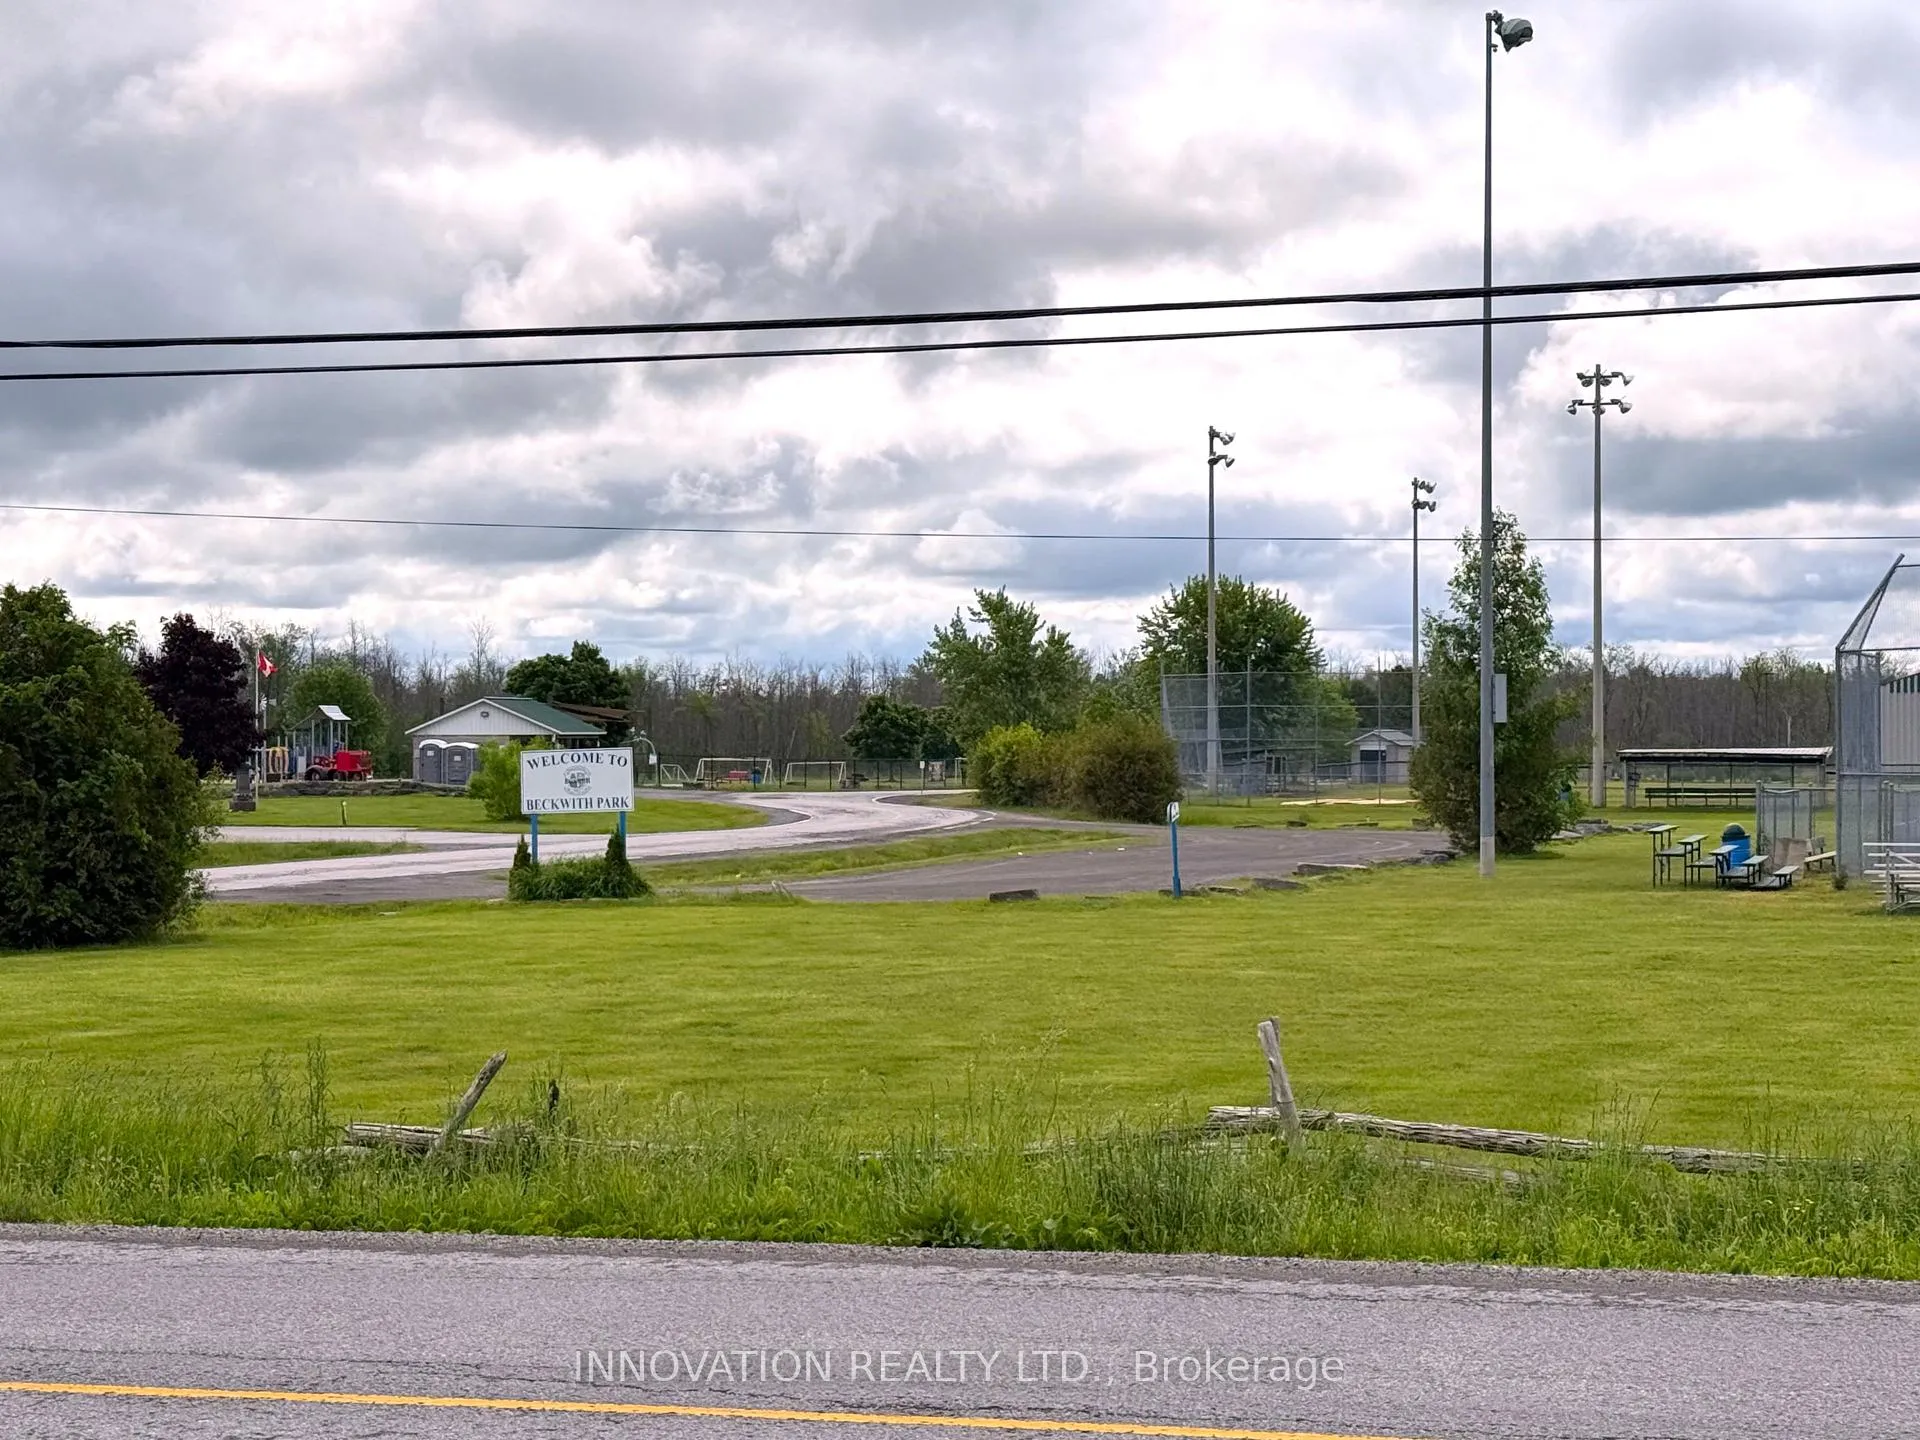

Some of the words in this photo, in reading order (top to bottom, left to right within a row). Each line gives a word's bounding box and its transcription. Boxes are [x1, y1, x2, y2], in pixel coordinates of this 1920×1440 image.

[527, 752, 604, 770] WELCOME
[608, 753, 628, 768] TO
[526, 798, 593, 811] BECKWITH
[597, 796, 630, 809] PARK
